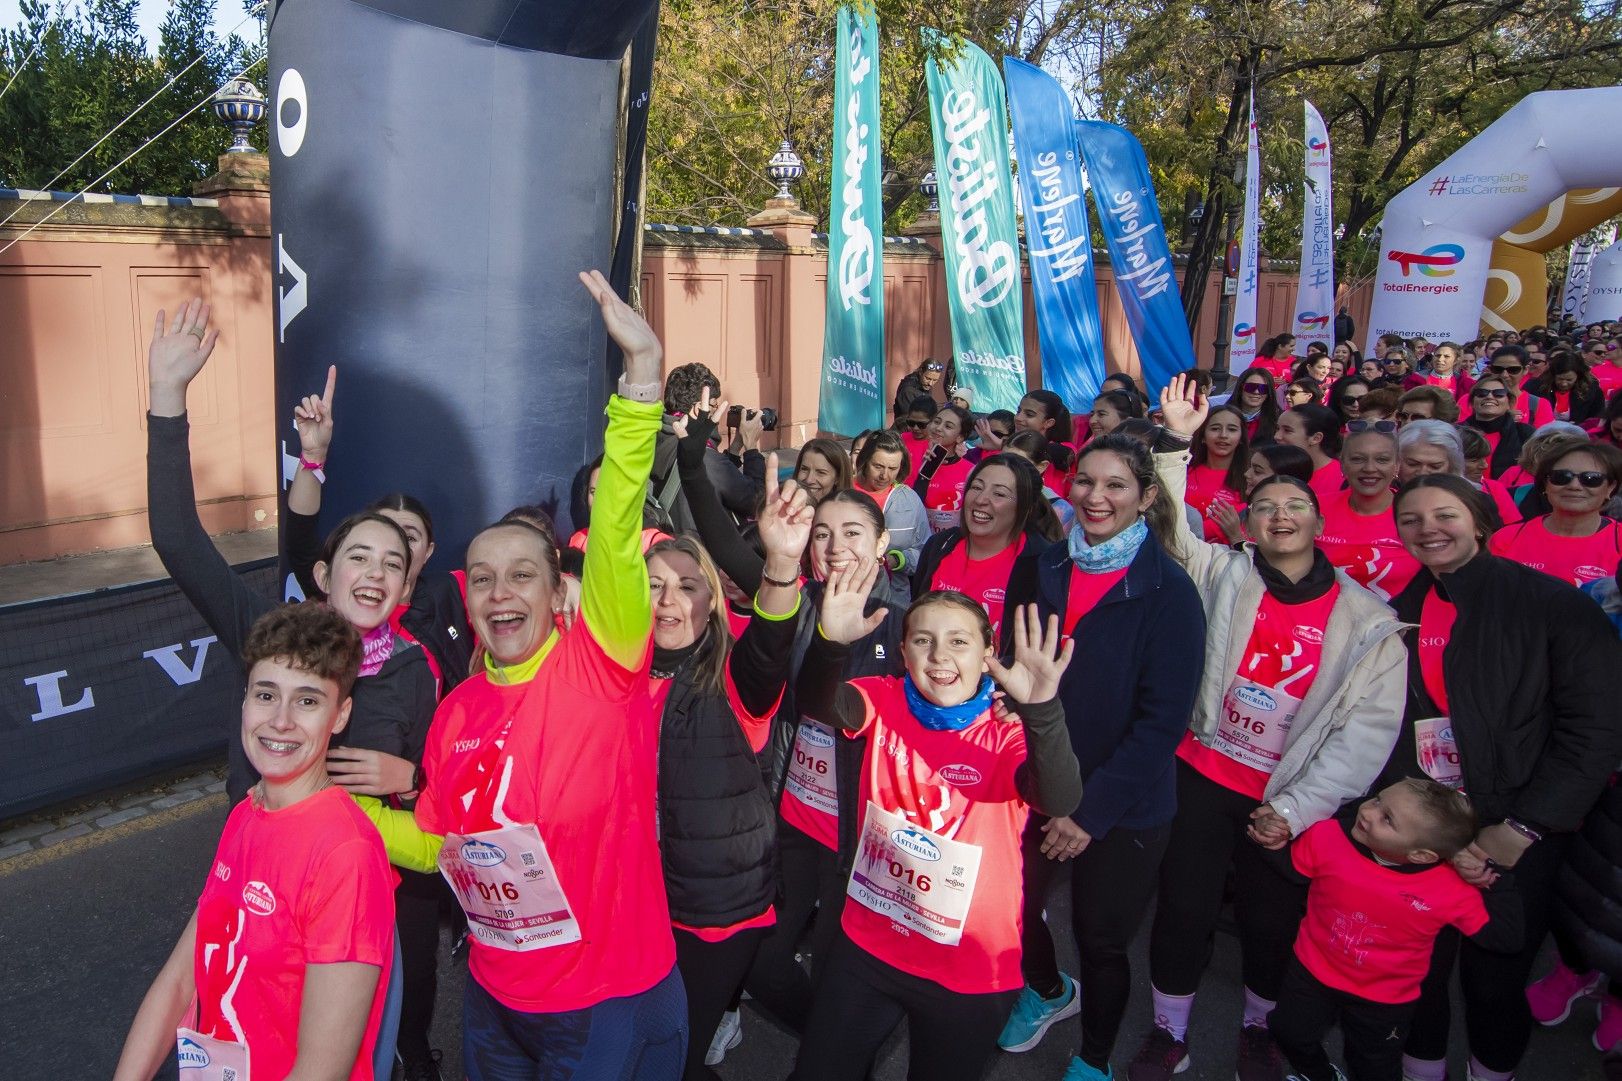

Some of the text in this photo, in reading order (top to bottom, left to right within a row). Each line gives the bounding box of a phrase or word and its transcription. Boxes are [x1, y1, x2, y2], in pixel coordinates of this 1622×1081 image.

[1383, 283, 1459, 295] TotalEnergies
[1376, 328, 1451, 338] totalenergies.es
[1236, 689, 1274, 711] ASTURIANA
[1228, 710, 1266, 735] 016
[796, 750, 828, 775] 016
[894, 833, 937, 860] ASTURIANA
[888, 861, 932, 893] 016
[478, 881, 519, 901] 016
[858, 888, 892, 911] OYSHO
[896, 885, 916, 901] 2118
[527, 915, 553, 926] SEVILLA
[912, 917, 946, 938] Santander
[523, 928, 563, 943] Santander
